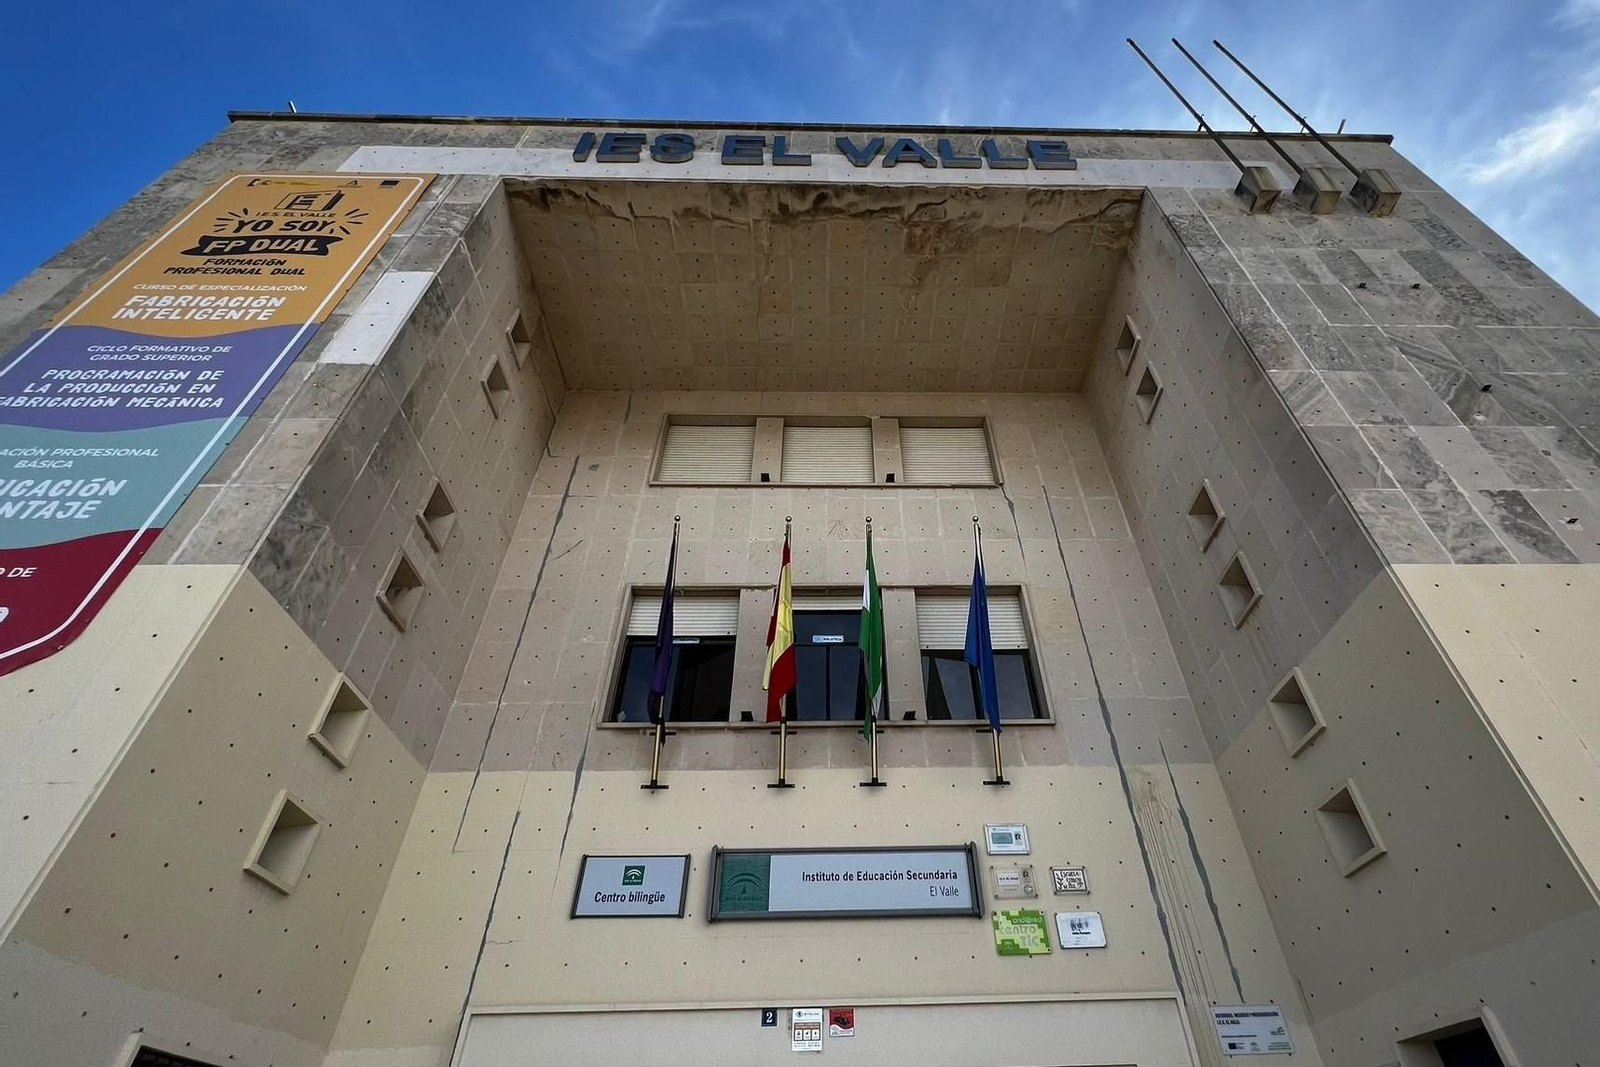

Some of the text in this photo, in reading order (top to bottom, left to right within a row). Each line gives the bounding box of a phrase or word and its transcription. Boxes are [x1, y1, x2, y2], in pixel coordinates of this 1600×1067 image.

[572, 132, 1077, 170] IES EL VALLE
[232, 219, 335, 233] YO SOY
[201, 238, 319, 254] FP DUAL
[203, 258, 287, 266] FORMACIÓN
[163, 267, 306, 276] PROFESIONAL DUAL
[199, 283, 308, 291] ESPECIALIZACIÓN
[125, 295, 286, 308] FABRICACIÓN
[111, 308, 275, 320] INTELIGENTE
[87, 345, 233, 353] CICLO FORMATIVO DE
[141, 354, 213, 362] SUPERIOR
[41, 369, 225, 381] PROGRAMACIÓN DE
[23, 382, 216, 394] LA PRODUCCIÓN EN
[125, 396, 224, 408] MECÁNICA
[51, 448, 159, 457] PROFESIONAL
[14, 459, 74, 469] BÁSICA
[7, 567, 37, 577] DE
[802, 869, 958, 882] Instituto de Educación Secundaria
[929, 885, 959, 897] El Valle
[594, 891, 665, 904] Centro bilingüe
[766, 1011, 773, 1023] 2
